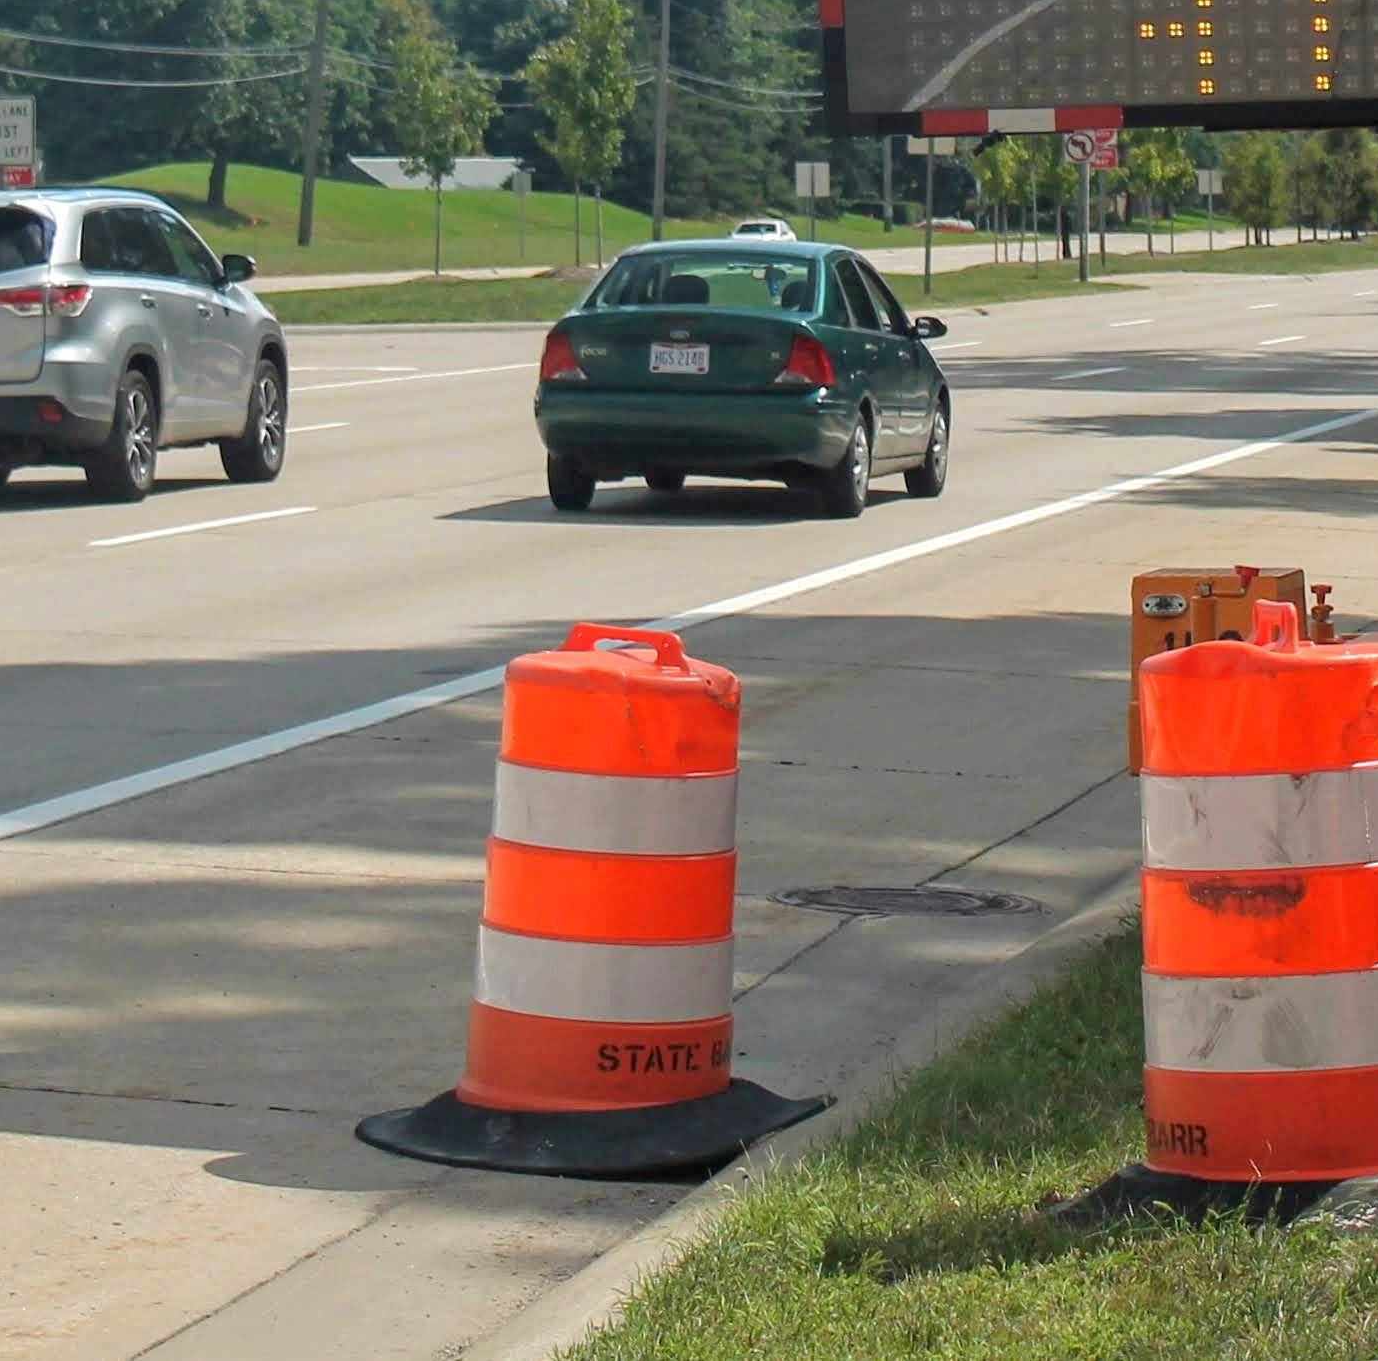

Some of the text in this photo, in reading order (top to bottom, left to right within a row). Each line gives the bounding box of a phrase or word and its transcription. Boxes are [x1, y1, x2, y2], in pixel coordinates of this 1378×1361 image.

[3, 105, 28, 118] LANE
[5, 146, 30, 157] LEFT
[597, 1042, 702, 1074] STATE
